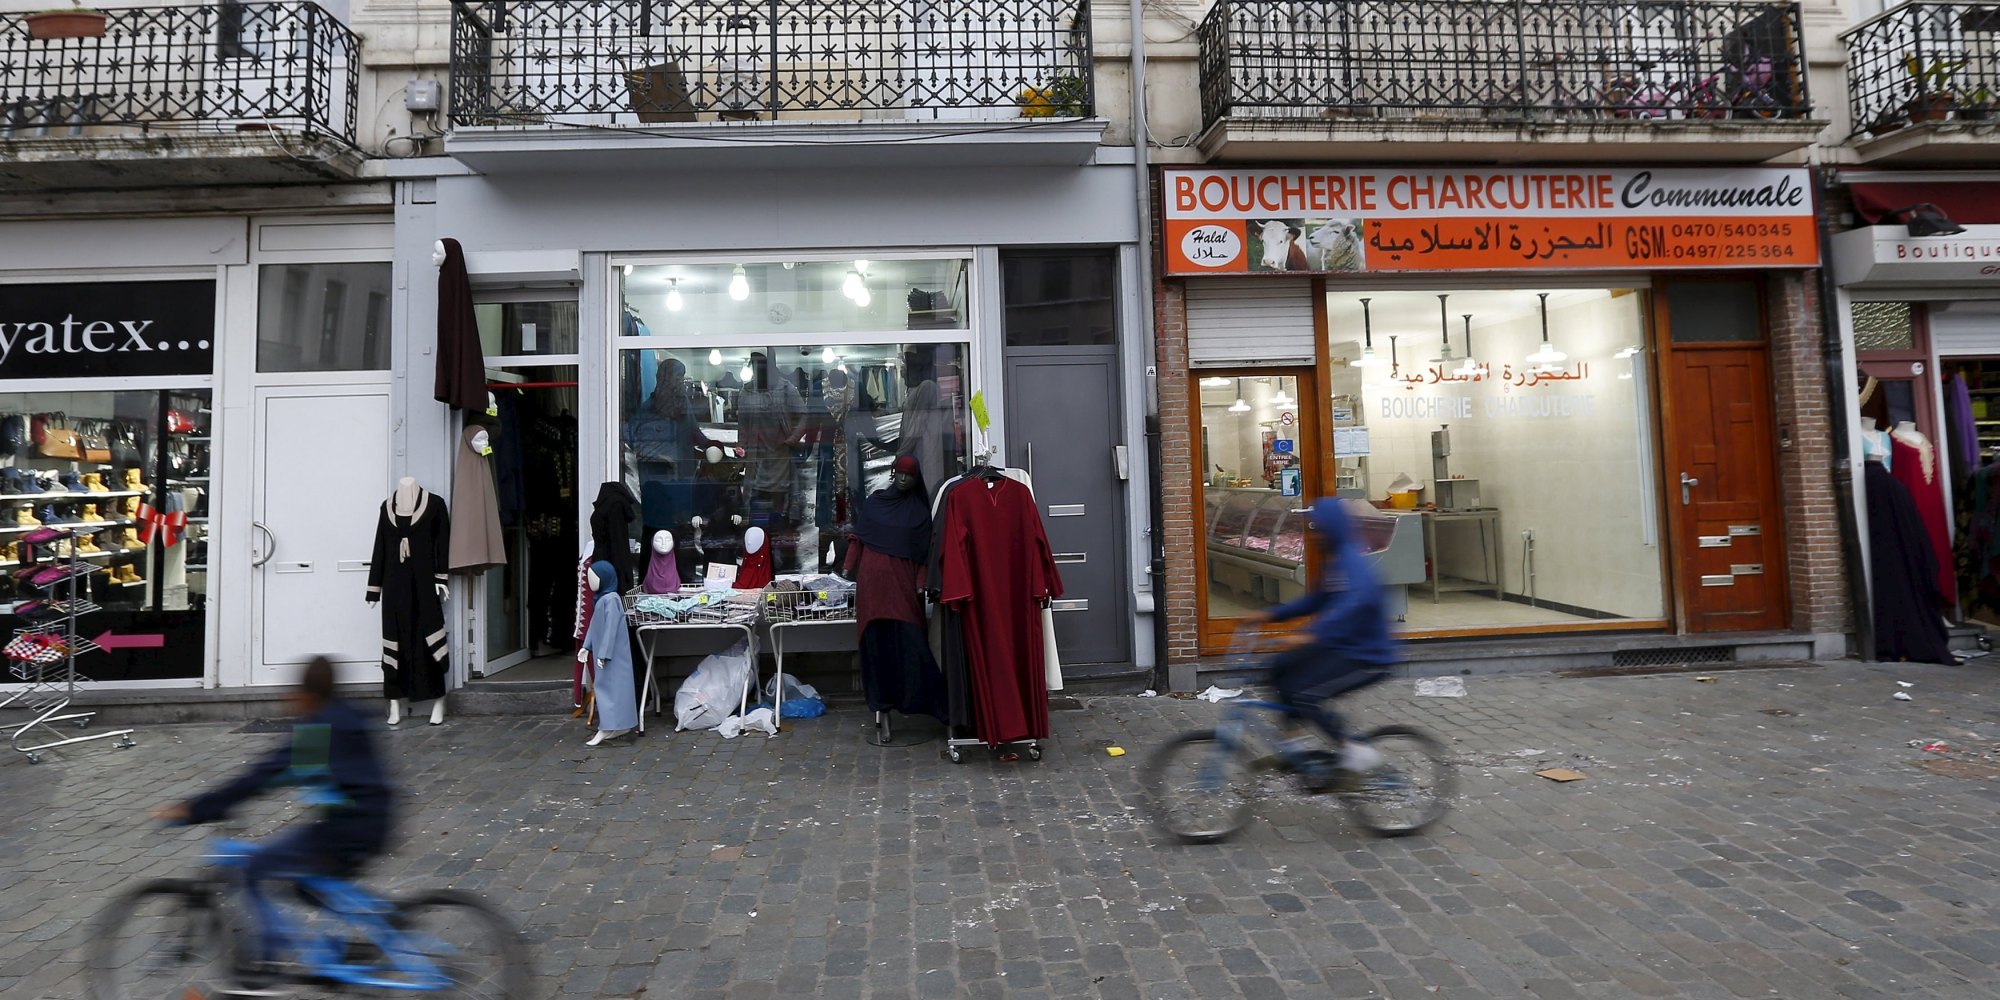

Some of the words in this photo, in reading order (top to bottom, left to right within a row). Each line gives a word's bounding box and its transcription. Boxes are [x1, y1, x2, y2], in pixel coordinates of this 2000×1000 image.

[1176, 175, 1377, 212] BOUCHERIE
[1387, 174, 1614, 210] CHARCUTERIE
[1621, 171, 1804, 209] Communale
[1191, 229, 1228, 244] Halal
[1370, 221, 1501, 260] الاسلامية
[1509, 222, 1613, 259] المجزرة
[1672, 223, 1792, 237] 0470/540345
[1192, 247, 1228, 259] حلال
[1502, 361, 1589, 386] المجزرة
[1381, 396, 1473, 419] BOUCHERIE
